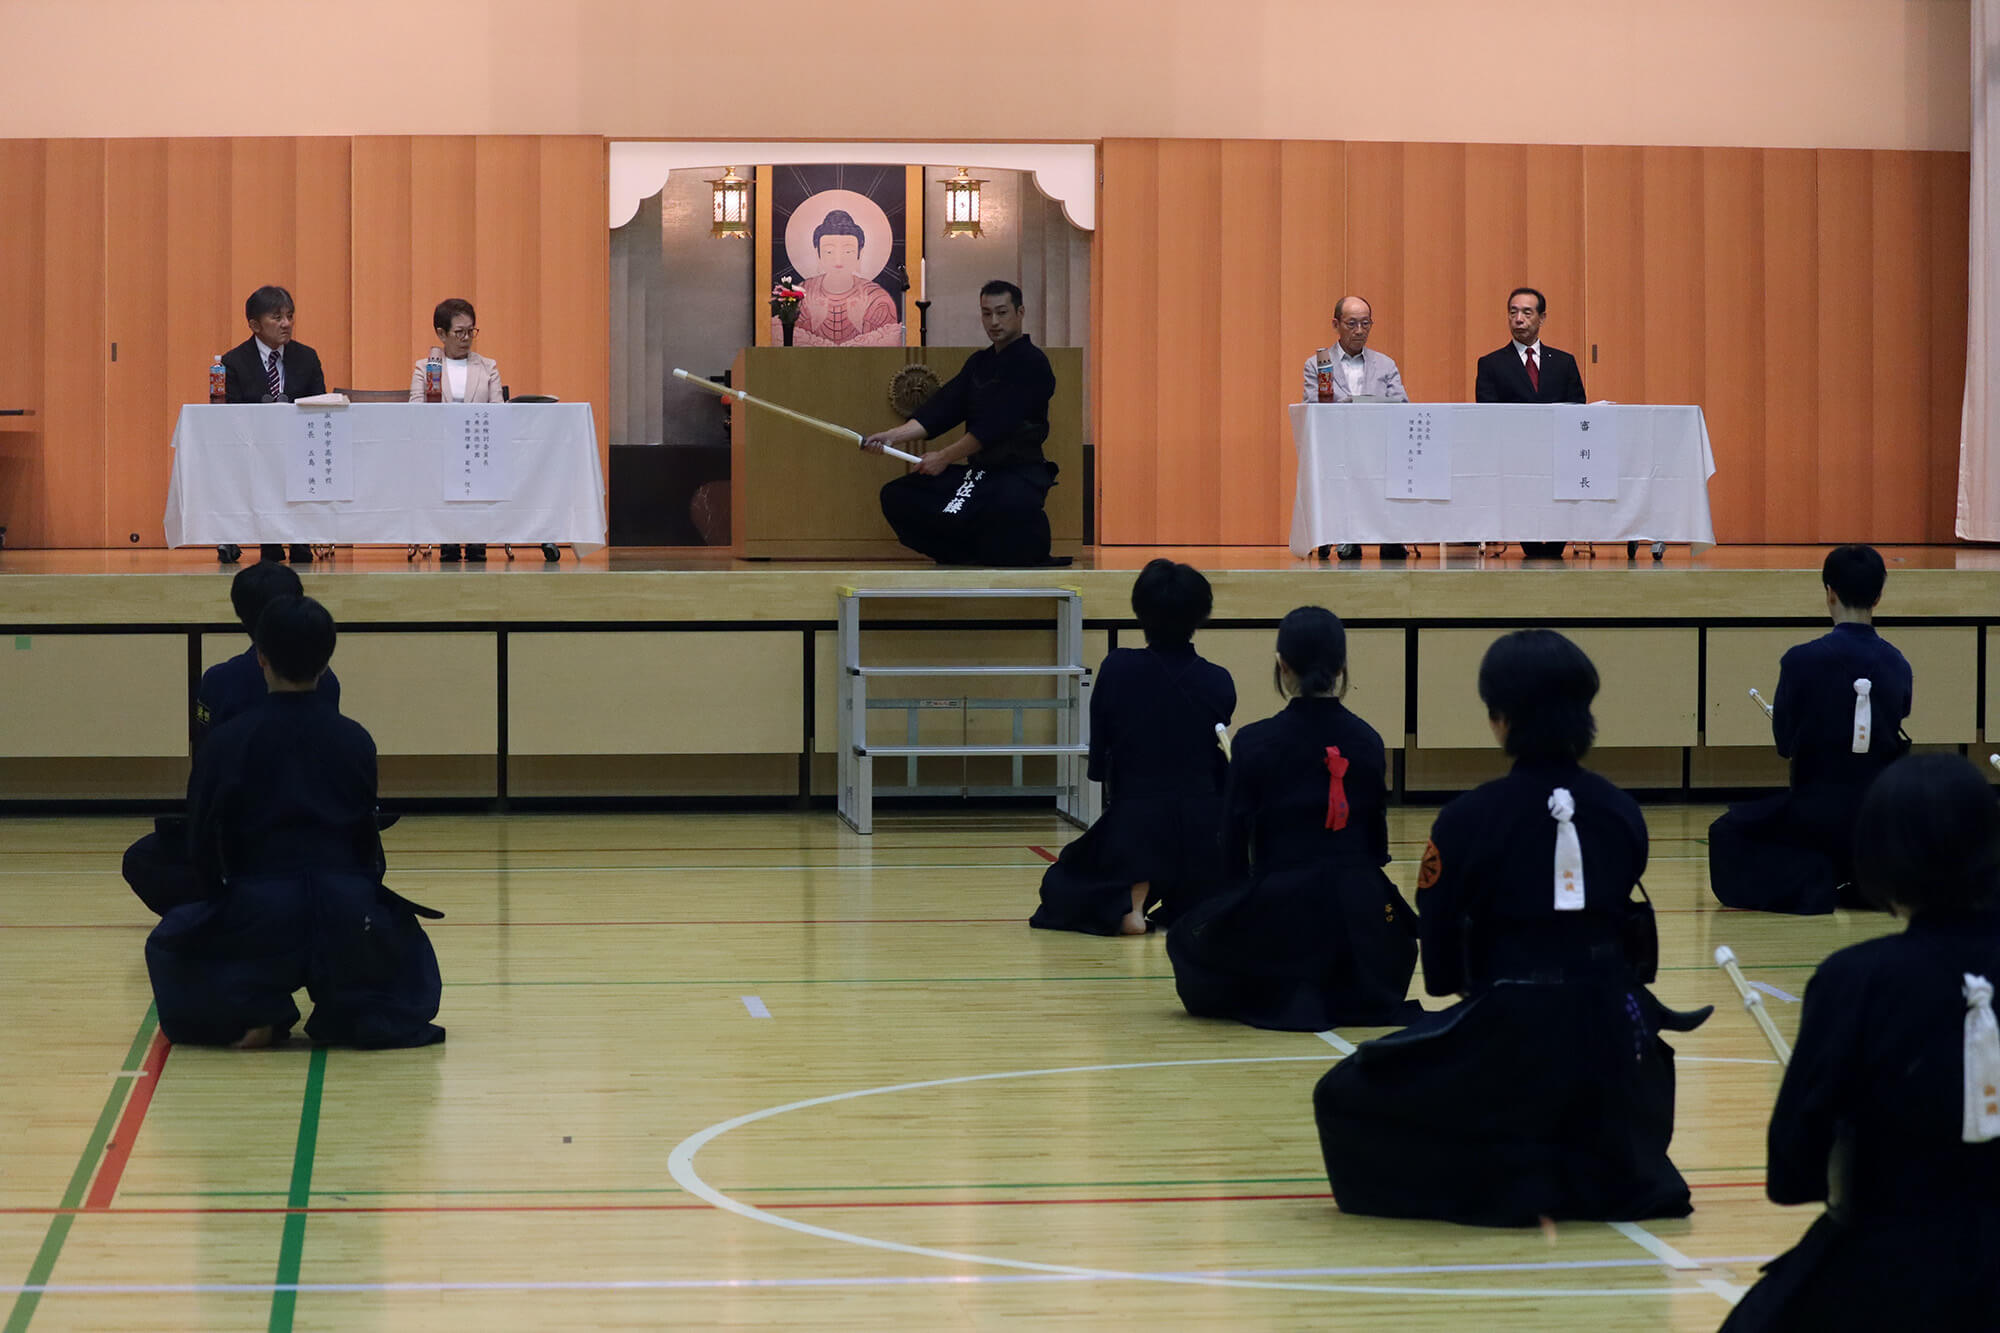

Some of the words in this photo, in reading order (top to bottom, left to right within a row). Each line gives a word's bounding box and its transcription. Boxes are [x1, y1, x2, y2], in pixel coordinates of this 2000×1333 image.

[307, 421, 316, 439] 校長
[1580, 420, 1591, 489] 審判長
[942, 480, 975, 514] 佐藤
